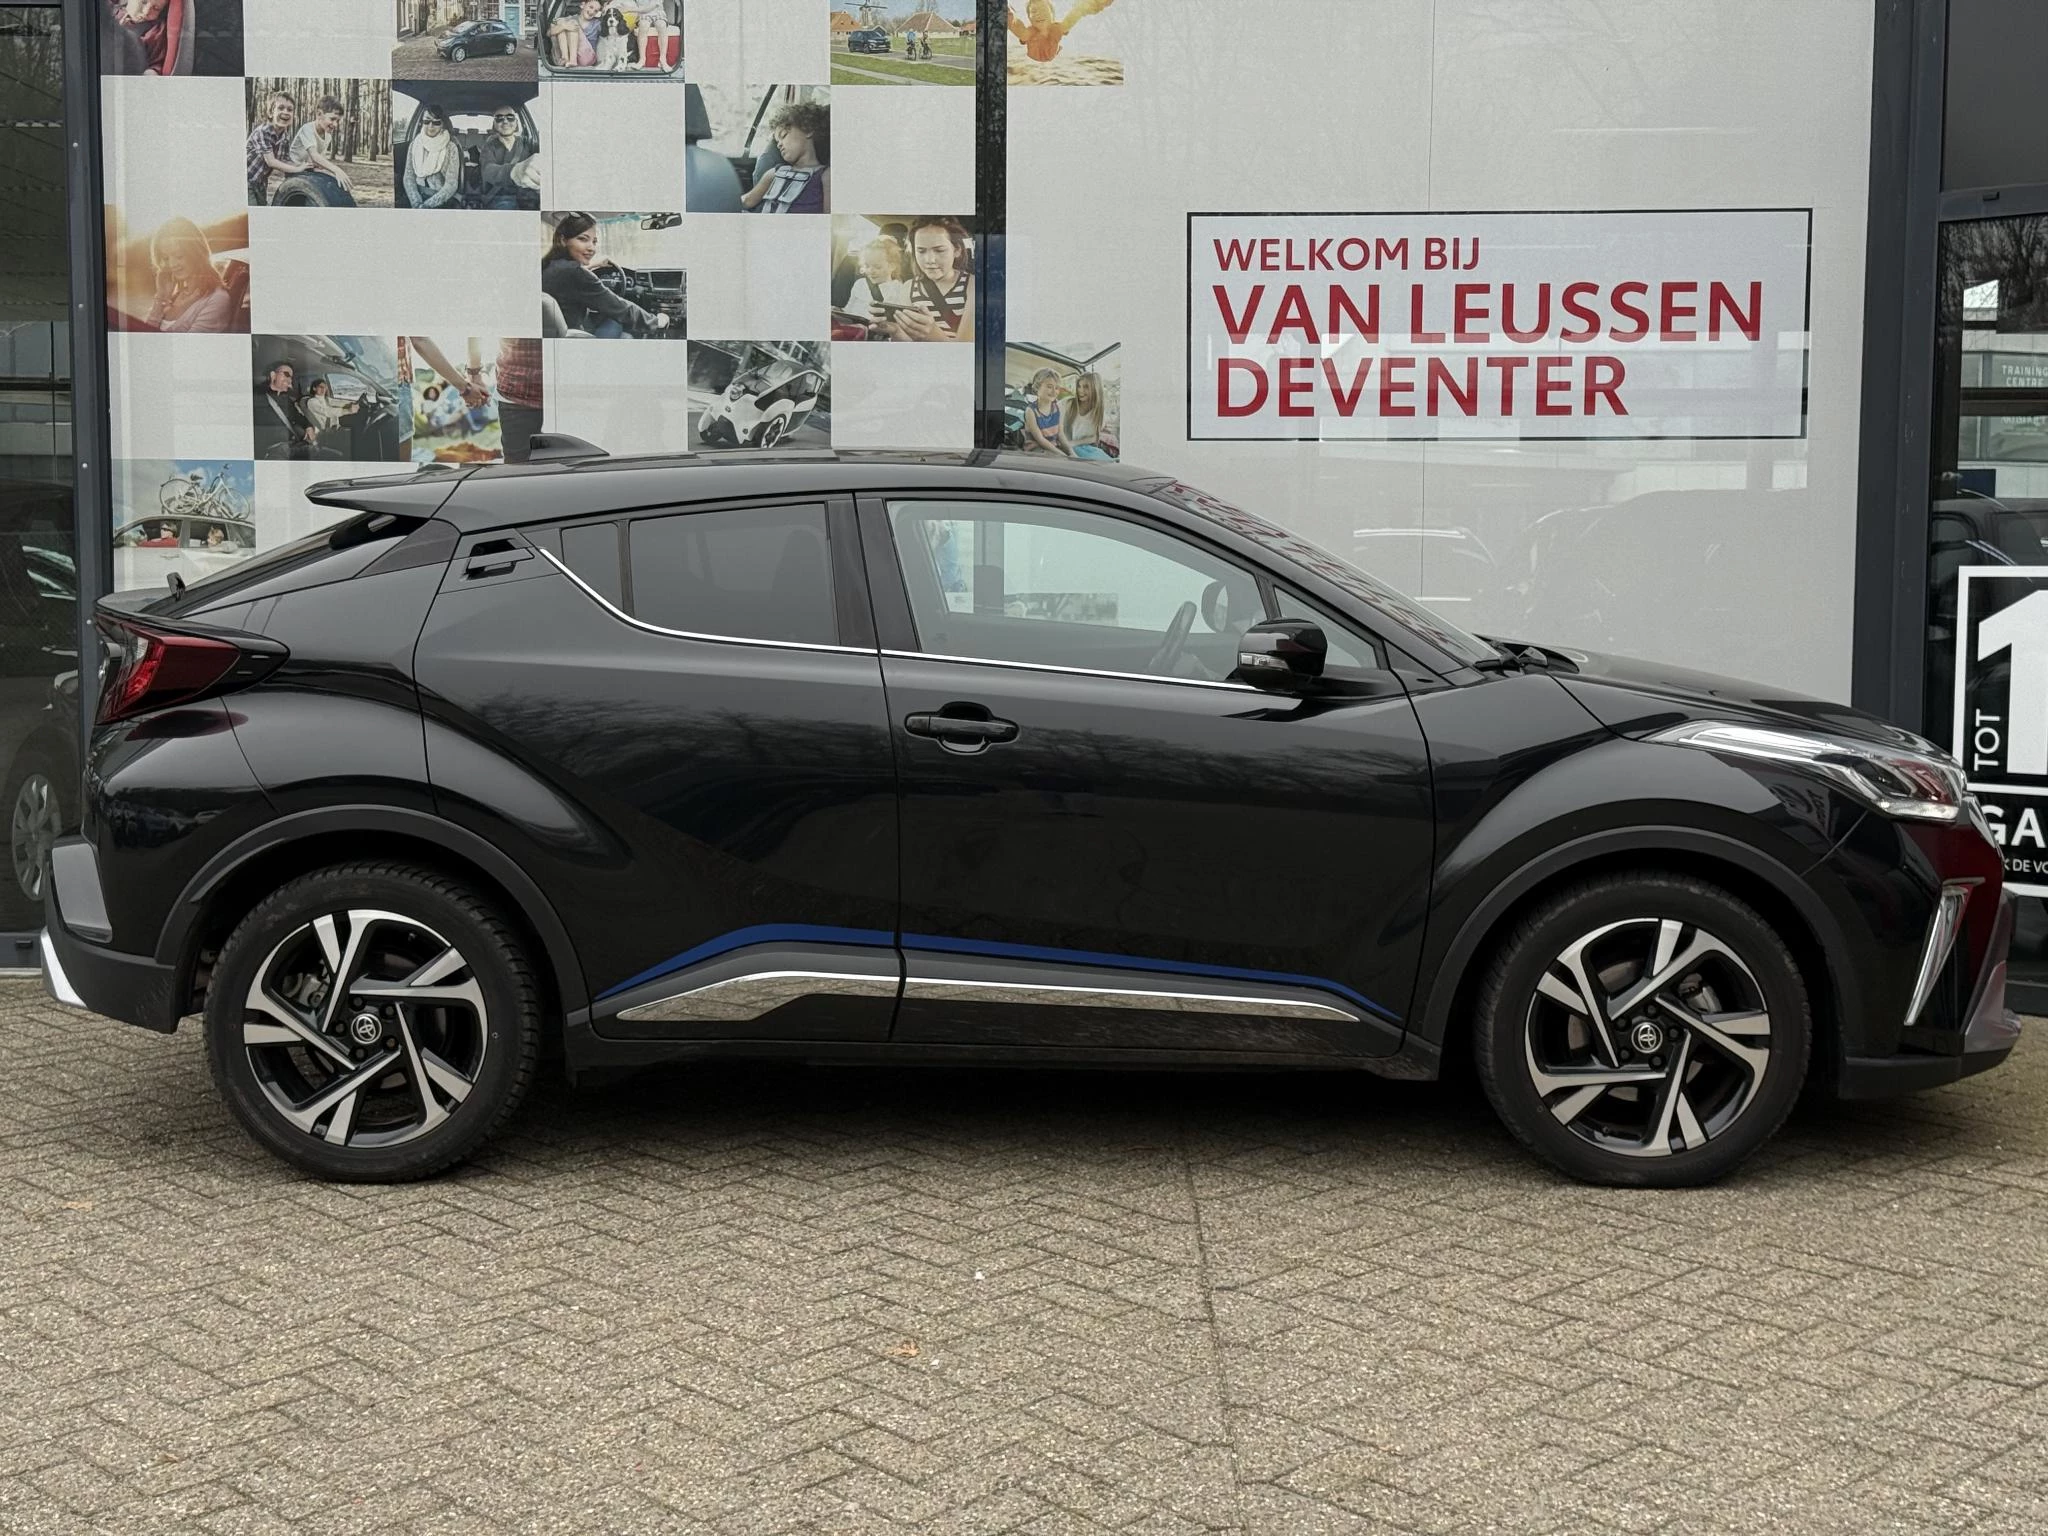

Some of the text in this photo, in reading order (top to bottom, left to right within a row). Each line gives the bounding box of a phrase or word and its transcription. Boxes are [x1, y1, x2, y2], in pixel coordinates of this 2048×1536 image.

[1213, 236, 1481, 272] WELKOM BIJ
[1213, 281, 1762, 345] VAN LEUSSEN
[1216, 355, 1628, 418] DEVENTER
[1973, 708, 2000, 772] TOT
[2013, 859, 2031, 873] DE
